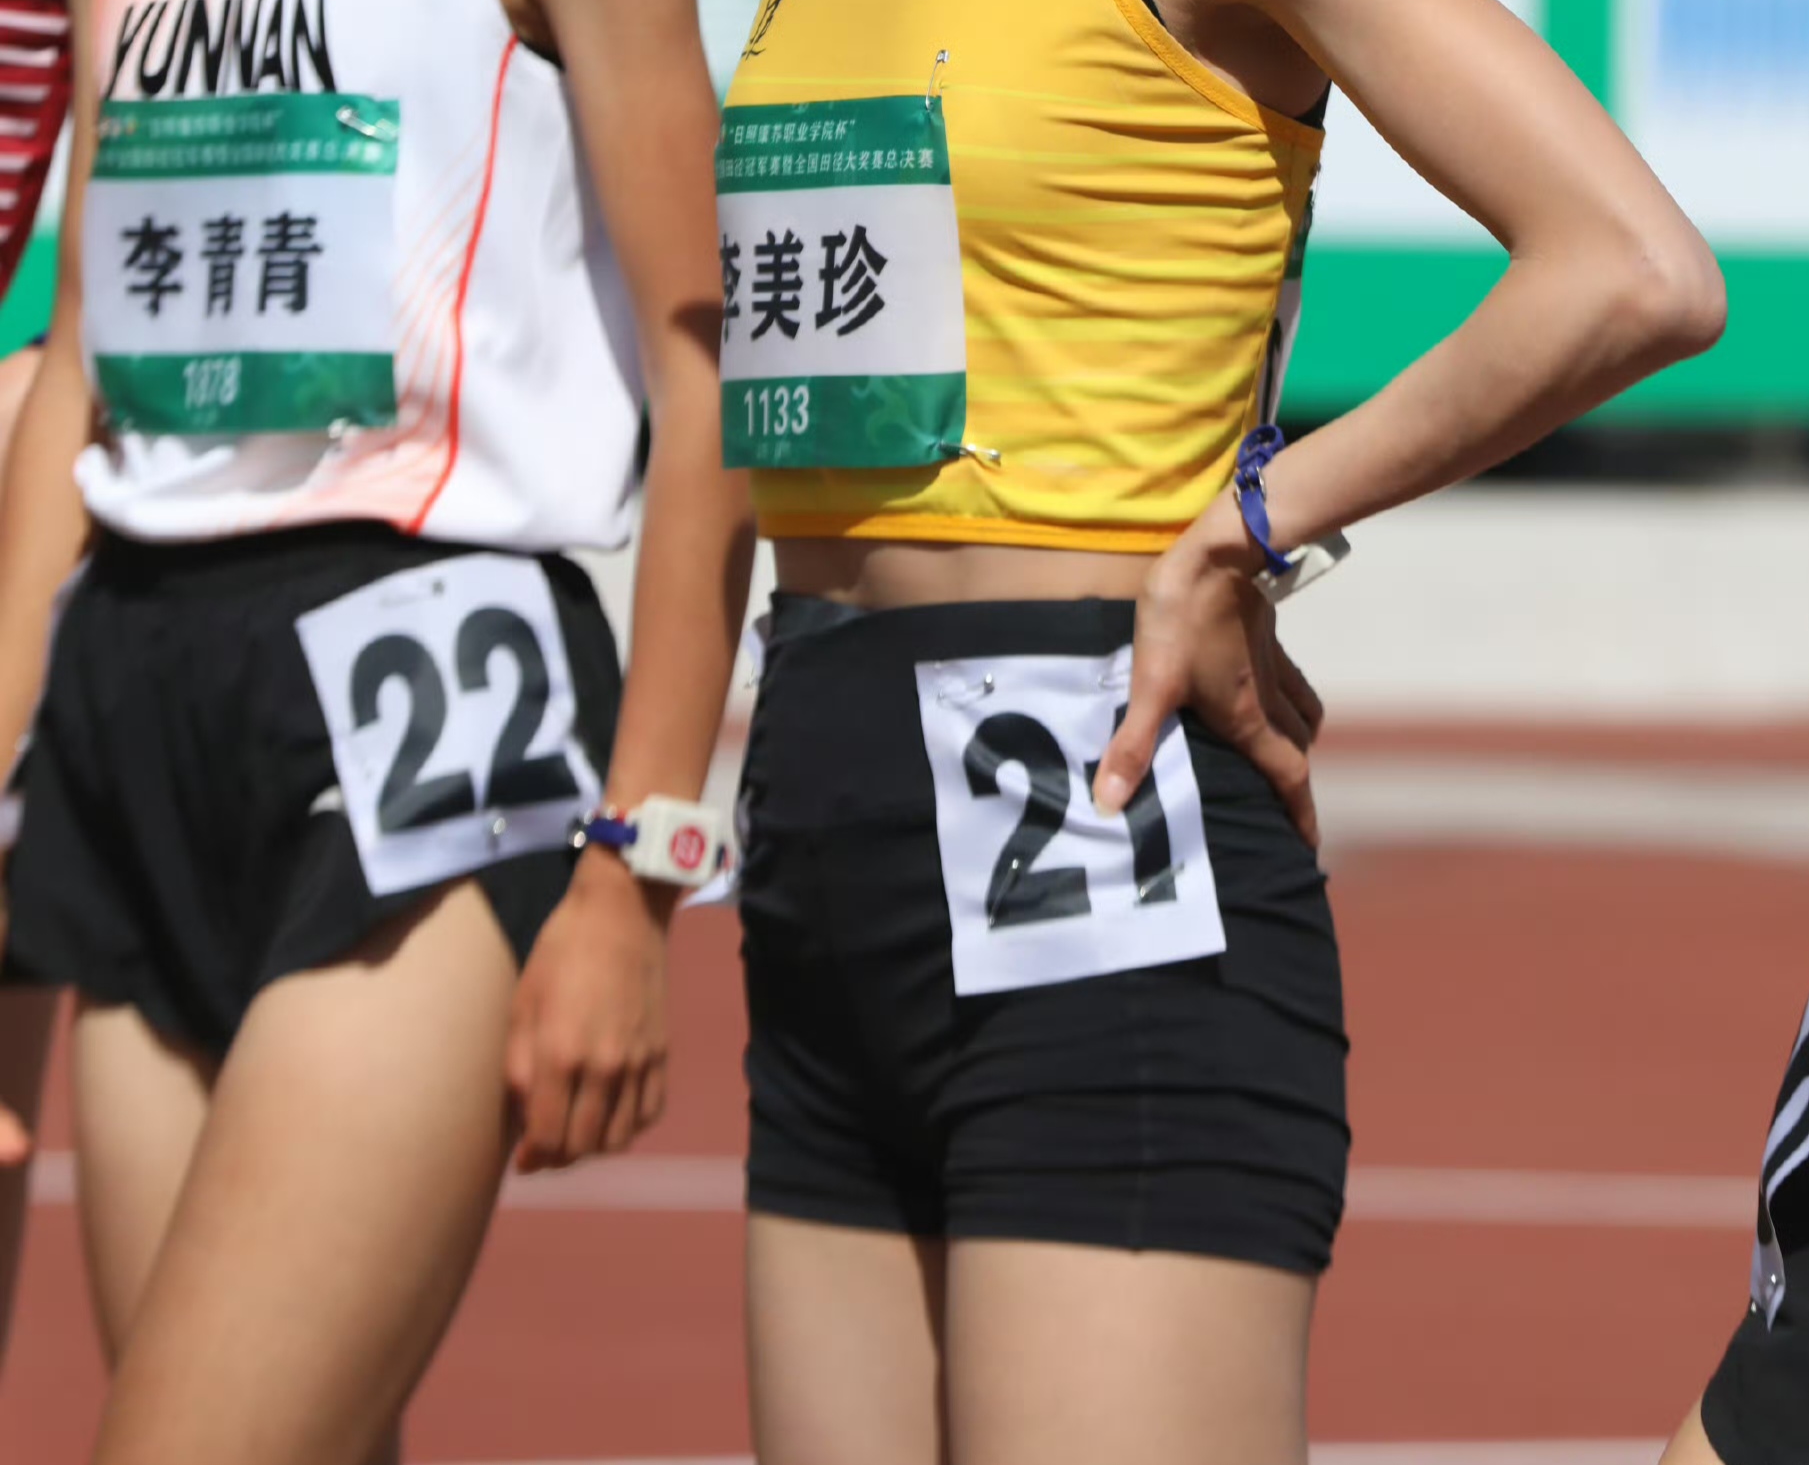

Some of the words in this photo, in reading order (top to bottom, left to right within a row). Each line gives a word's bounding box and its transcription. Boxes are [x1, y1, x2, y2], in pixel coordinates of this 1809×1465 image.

[121, 211, 324, 317] 李青青
[744, 386, 810, 437] 1133
[351, 606, 581, 833] 22
